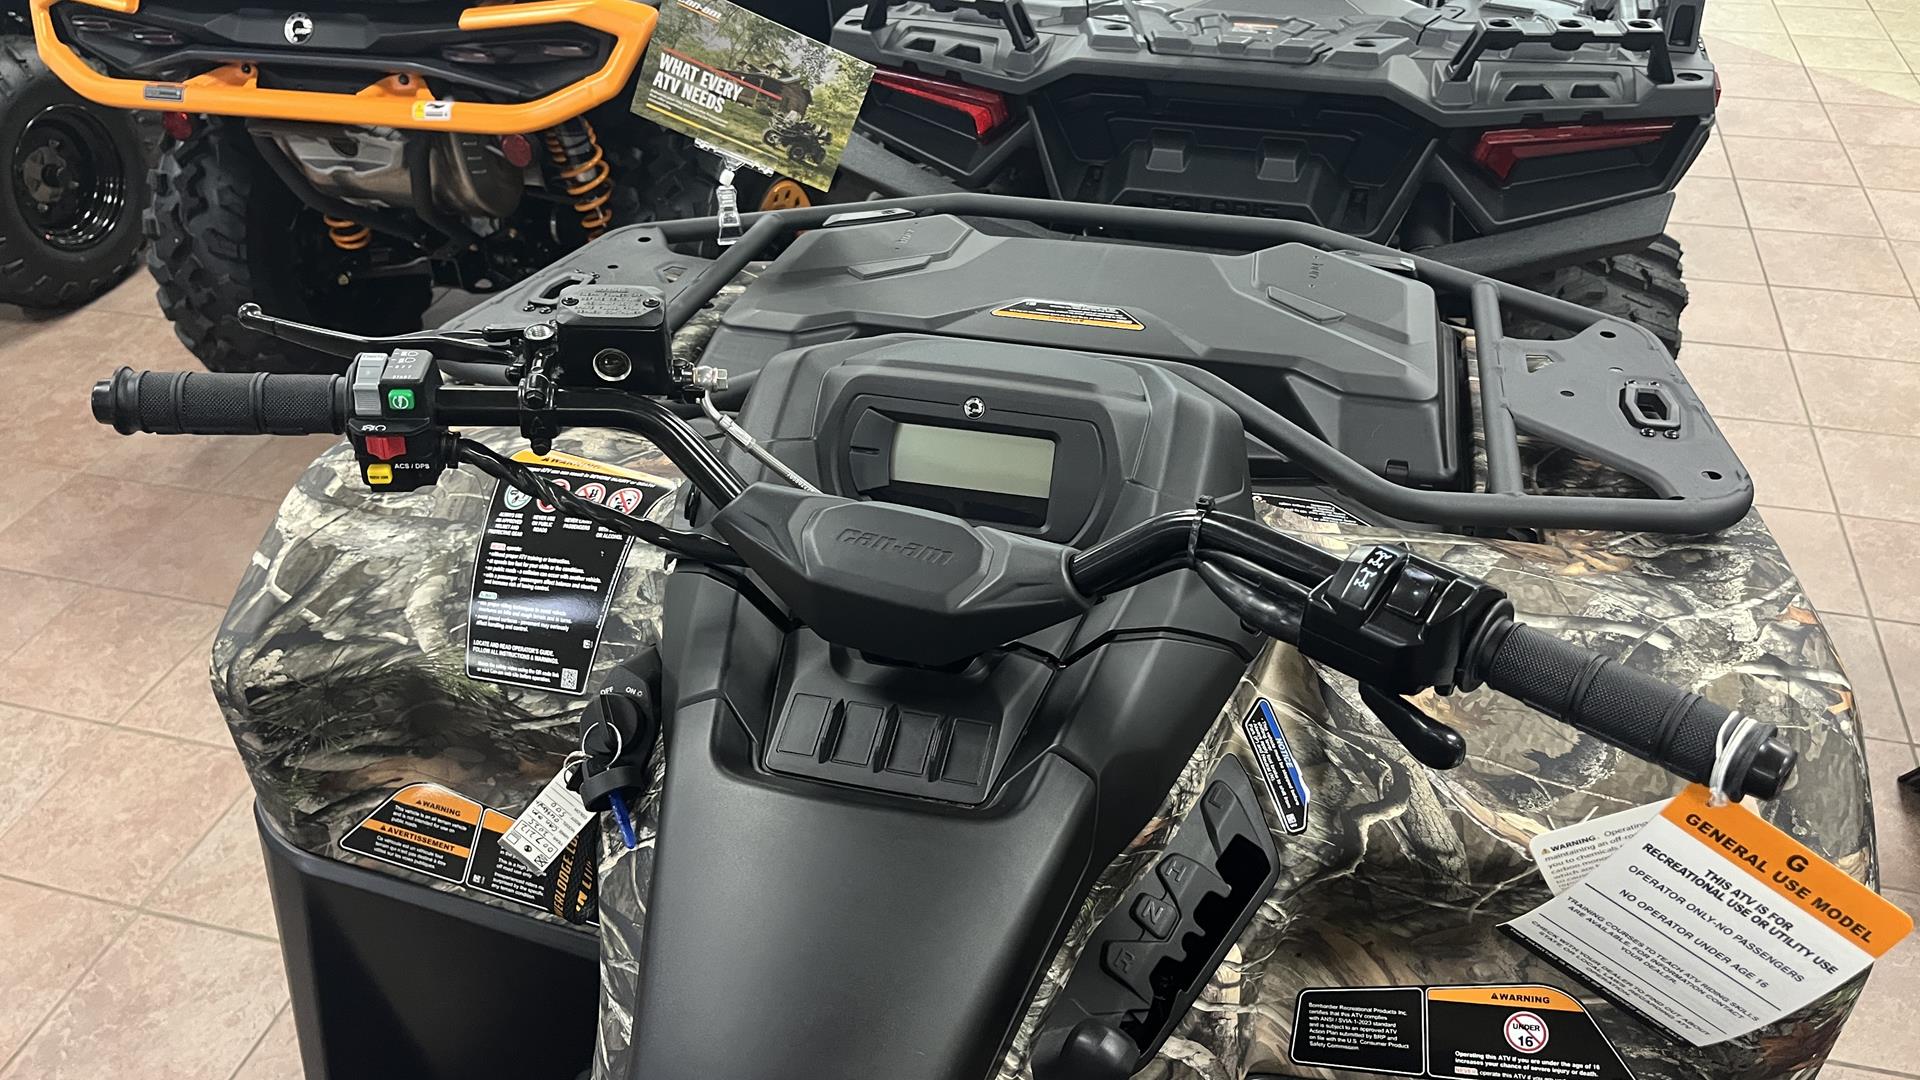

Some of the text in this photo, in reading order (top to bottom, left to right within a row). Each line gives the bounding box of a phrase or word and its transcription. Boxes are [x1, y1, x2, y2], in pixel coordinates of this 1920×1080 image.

[659, 51, 700, 82] WHAT
[699, 70, 743, 101] EVERY
[652, 70, 681, 94] ATV
[680, 82, 725, 113] NEEDS
[394, 462, 411, 470] ACS
[835, 527, 953, 566] can-am
[600, 685, 614, 695] OFF
[625, 686, 637, 695] ON
[1274, 737, 1293, 768] NOTICE
[422, 800, 460, 816] WARNING
[550, 801, 567, 818] 500
[387, 826, 455, 851] AVERTISSEMENT
[528, 818, 549, 838] 2025
[1603, 820, 1649, 839] Operating
[1544, 844, 1596, 862] maintaining
[1597, 840, 1609, 849] an
[1548, 860, 1565, 870] you
[1565, 855, 1575, 864] to
[1785, 854, 1809, 873] G
[1685, 813, 1872, 943] GENERAL USE MODEL
[1641, 842, 1838, 974] RECREATIONAL USE OR UTILITY USE
[1704, 868, 1793, 931] THIS ATV IS FOR
[1141, 900, 1164, 926] N
[1628, 864, 1686, 904] OPERATOR
[1685, 903, 1733, 935] ONLY-NO
[1732, 934, 1804, 982] PASSENGERS
[1618, 888, 1769, 988] NO OPERATOR UNDER AGE 16
[1113, 947, 1136, 975] R
[1567, 896, 1759, 1021] TRAINING COURSES TO TEACH ATV RIDING SKILLS
[1567, 905, 1744, 1018] ARE AVAILABLE. FOR INFORMATION CONTACT
[1620, 946, 1676, 983] YOUR DEALER.
[1499, 992, 1550, 1004] WARNING
[1511, 1022, 1541, 1032] UNDER
[1517, 1034, 1534, 1047] 16
[1454, 1050, 1484, 1060] Operating
[1454, 1057, 1484, 1066] Increases
[1499, 1061, 1522, 1069] chance
[1551, 1067, 1570, 1075] injury
[1578, 1069, 1598, 1077] death.
